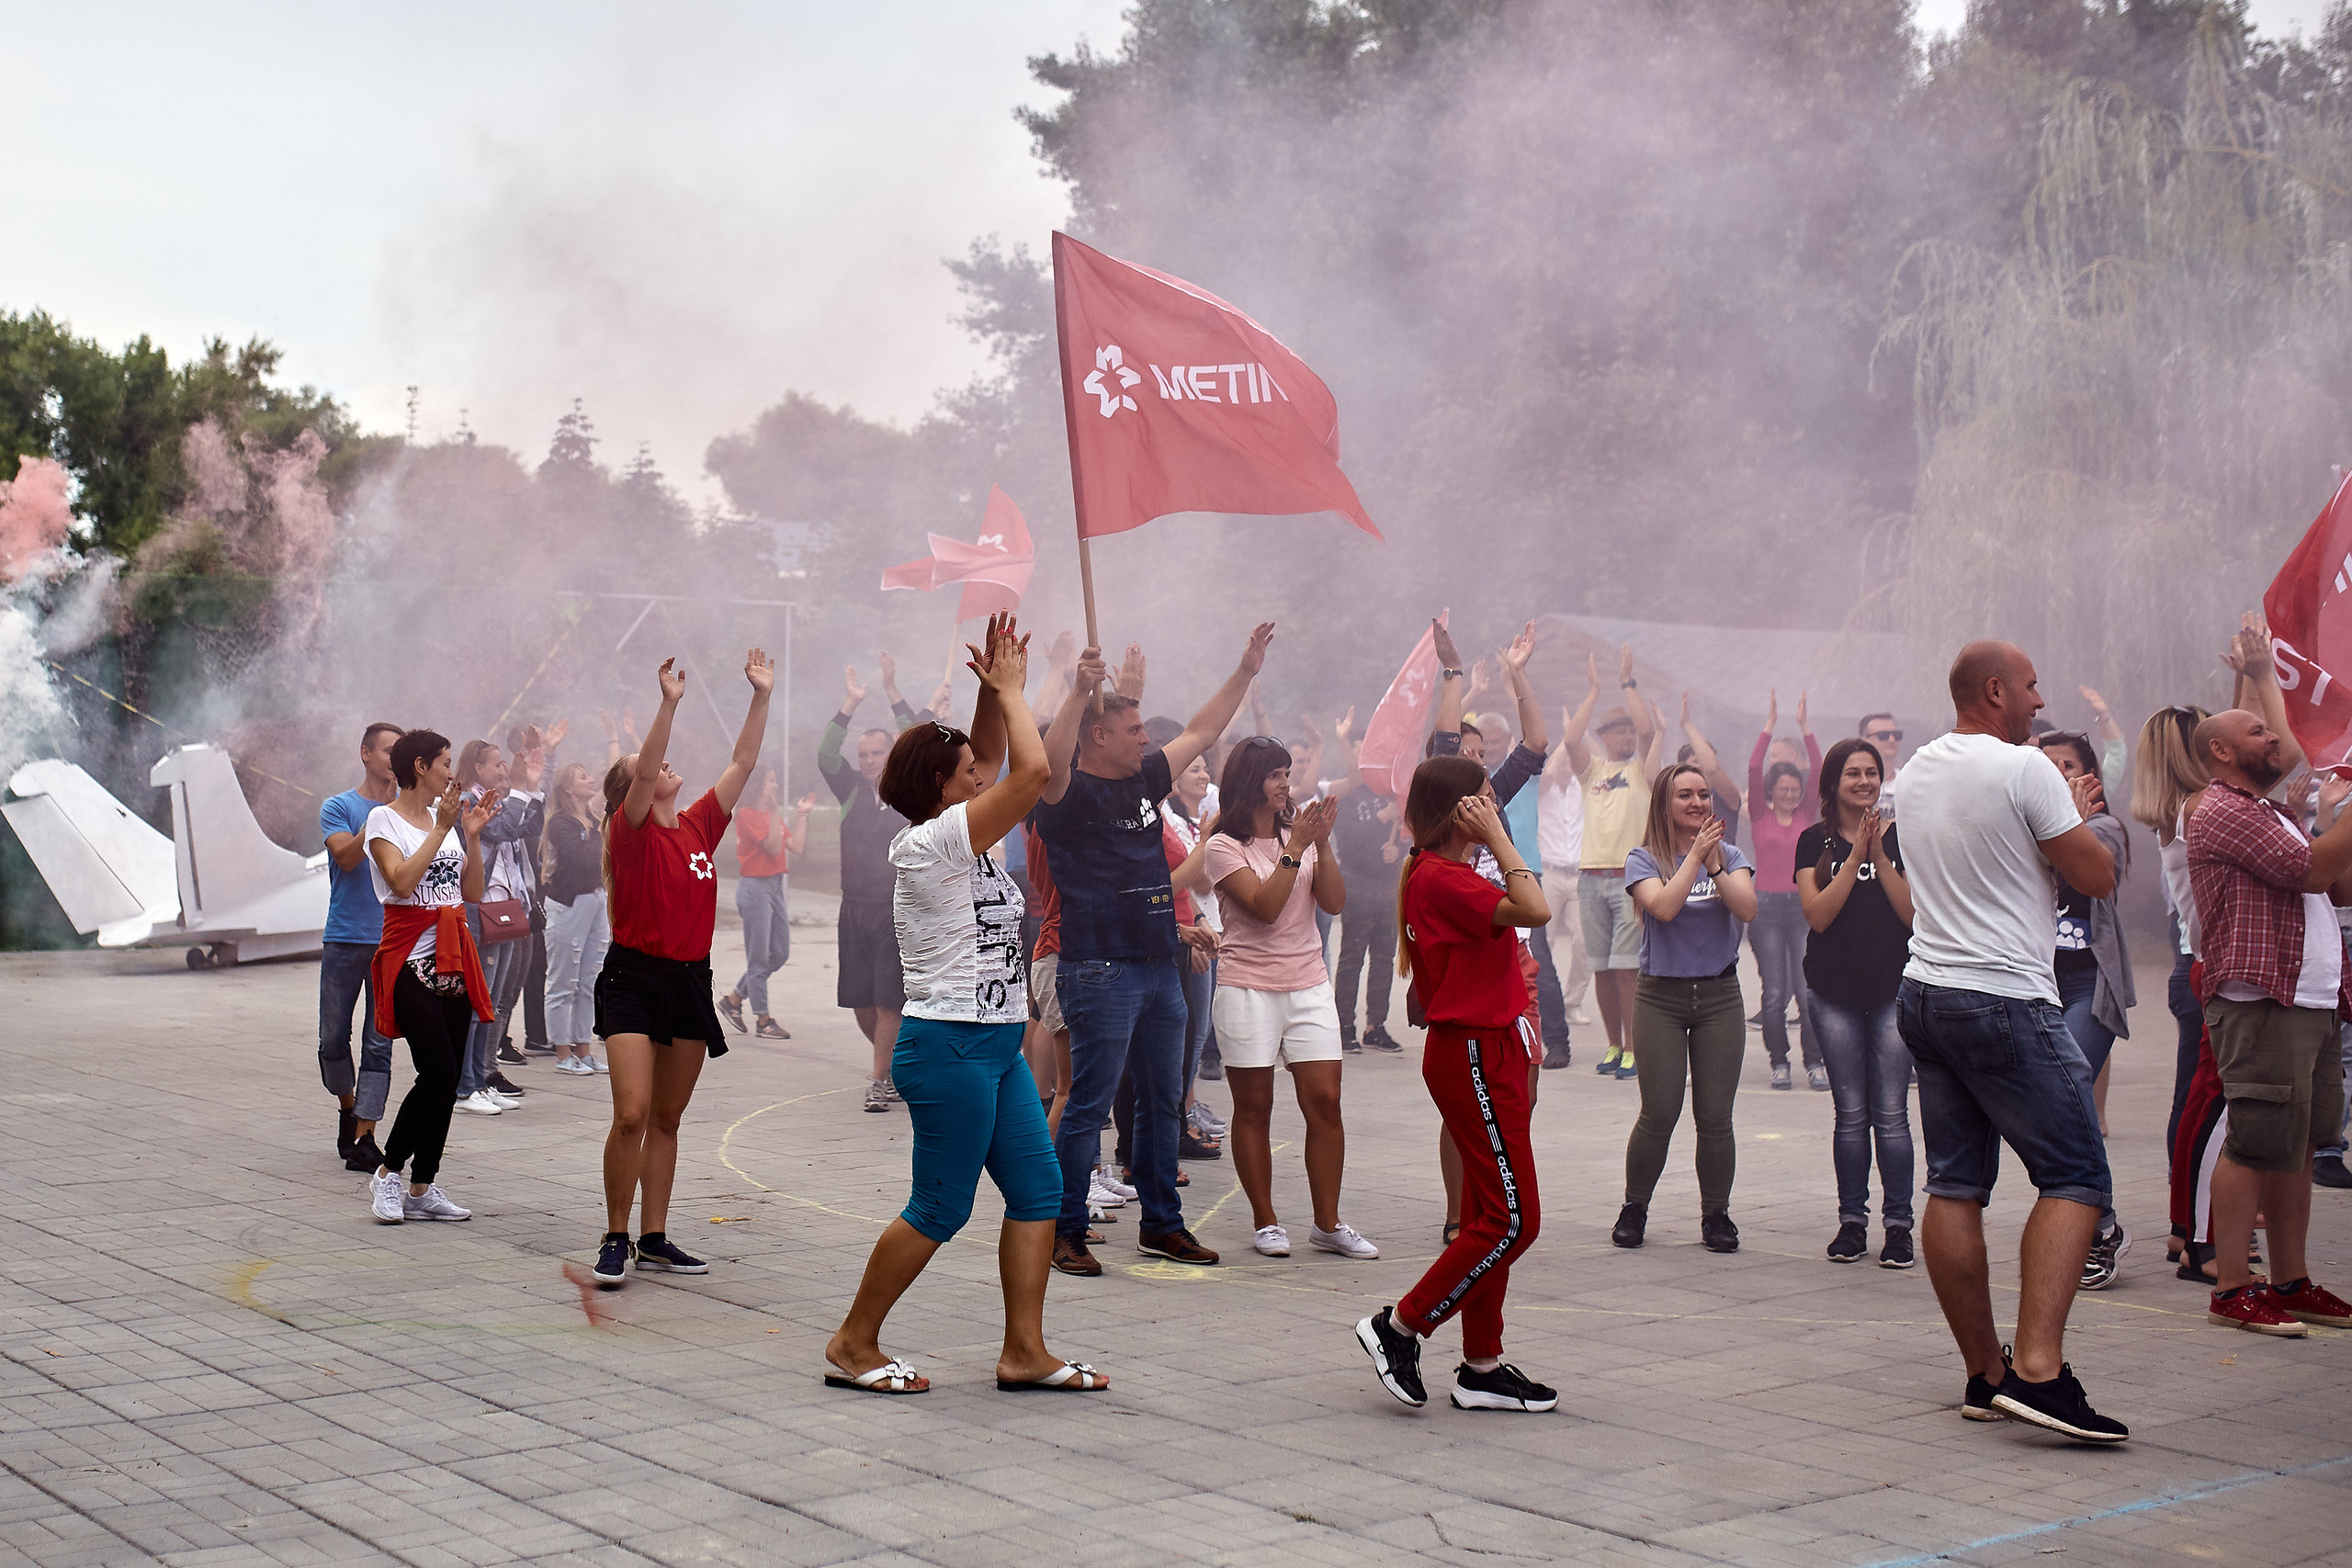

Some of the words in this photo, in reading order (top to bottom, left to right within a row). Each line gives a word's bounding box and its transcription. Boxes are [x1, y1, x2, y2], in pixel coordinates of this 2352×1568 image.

[1471, 1066, 1493, 1121] adidas
[1497, 1156, 1517, 1210] adidas
[1470, 1238, 1510, 1279] adidas
